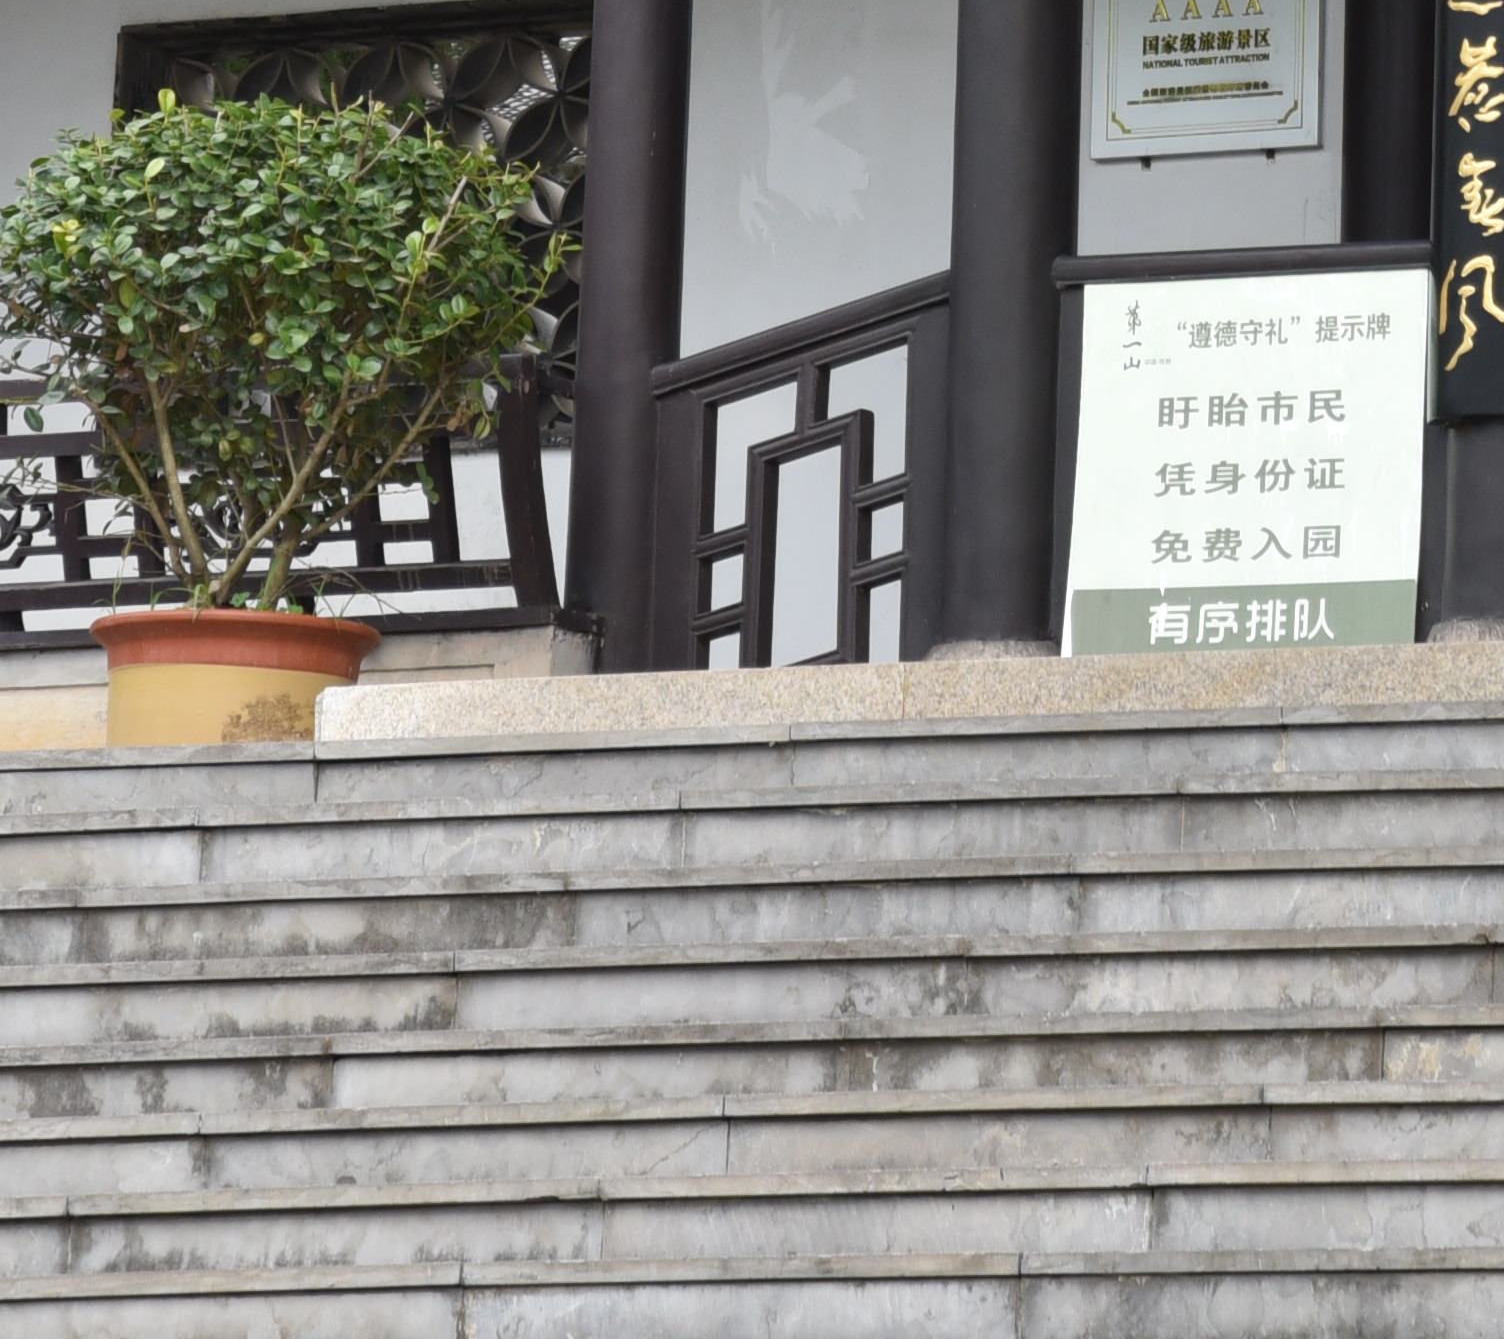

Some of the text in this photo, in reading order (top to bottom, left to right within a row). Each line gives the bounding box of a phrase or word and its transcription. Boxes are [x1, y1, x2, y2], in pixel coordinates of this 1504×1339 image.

[1142, 27, 1271, 56] 国家级旅游景区
[1142, 53, 1270, 70] NATIONAL TOURIST ATTRACTION
[1157, 389, 1346, 429] 盱眙市民
[1153, 457, 1346, 498] 凭身份证
[1151, 524, 1343, 565] 免费入园
[1148, 597, 1336, 646] 有序排队
